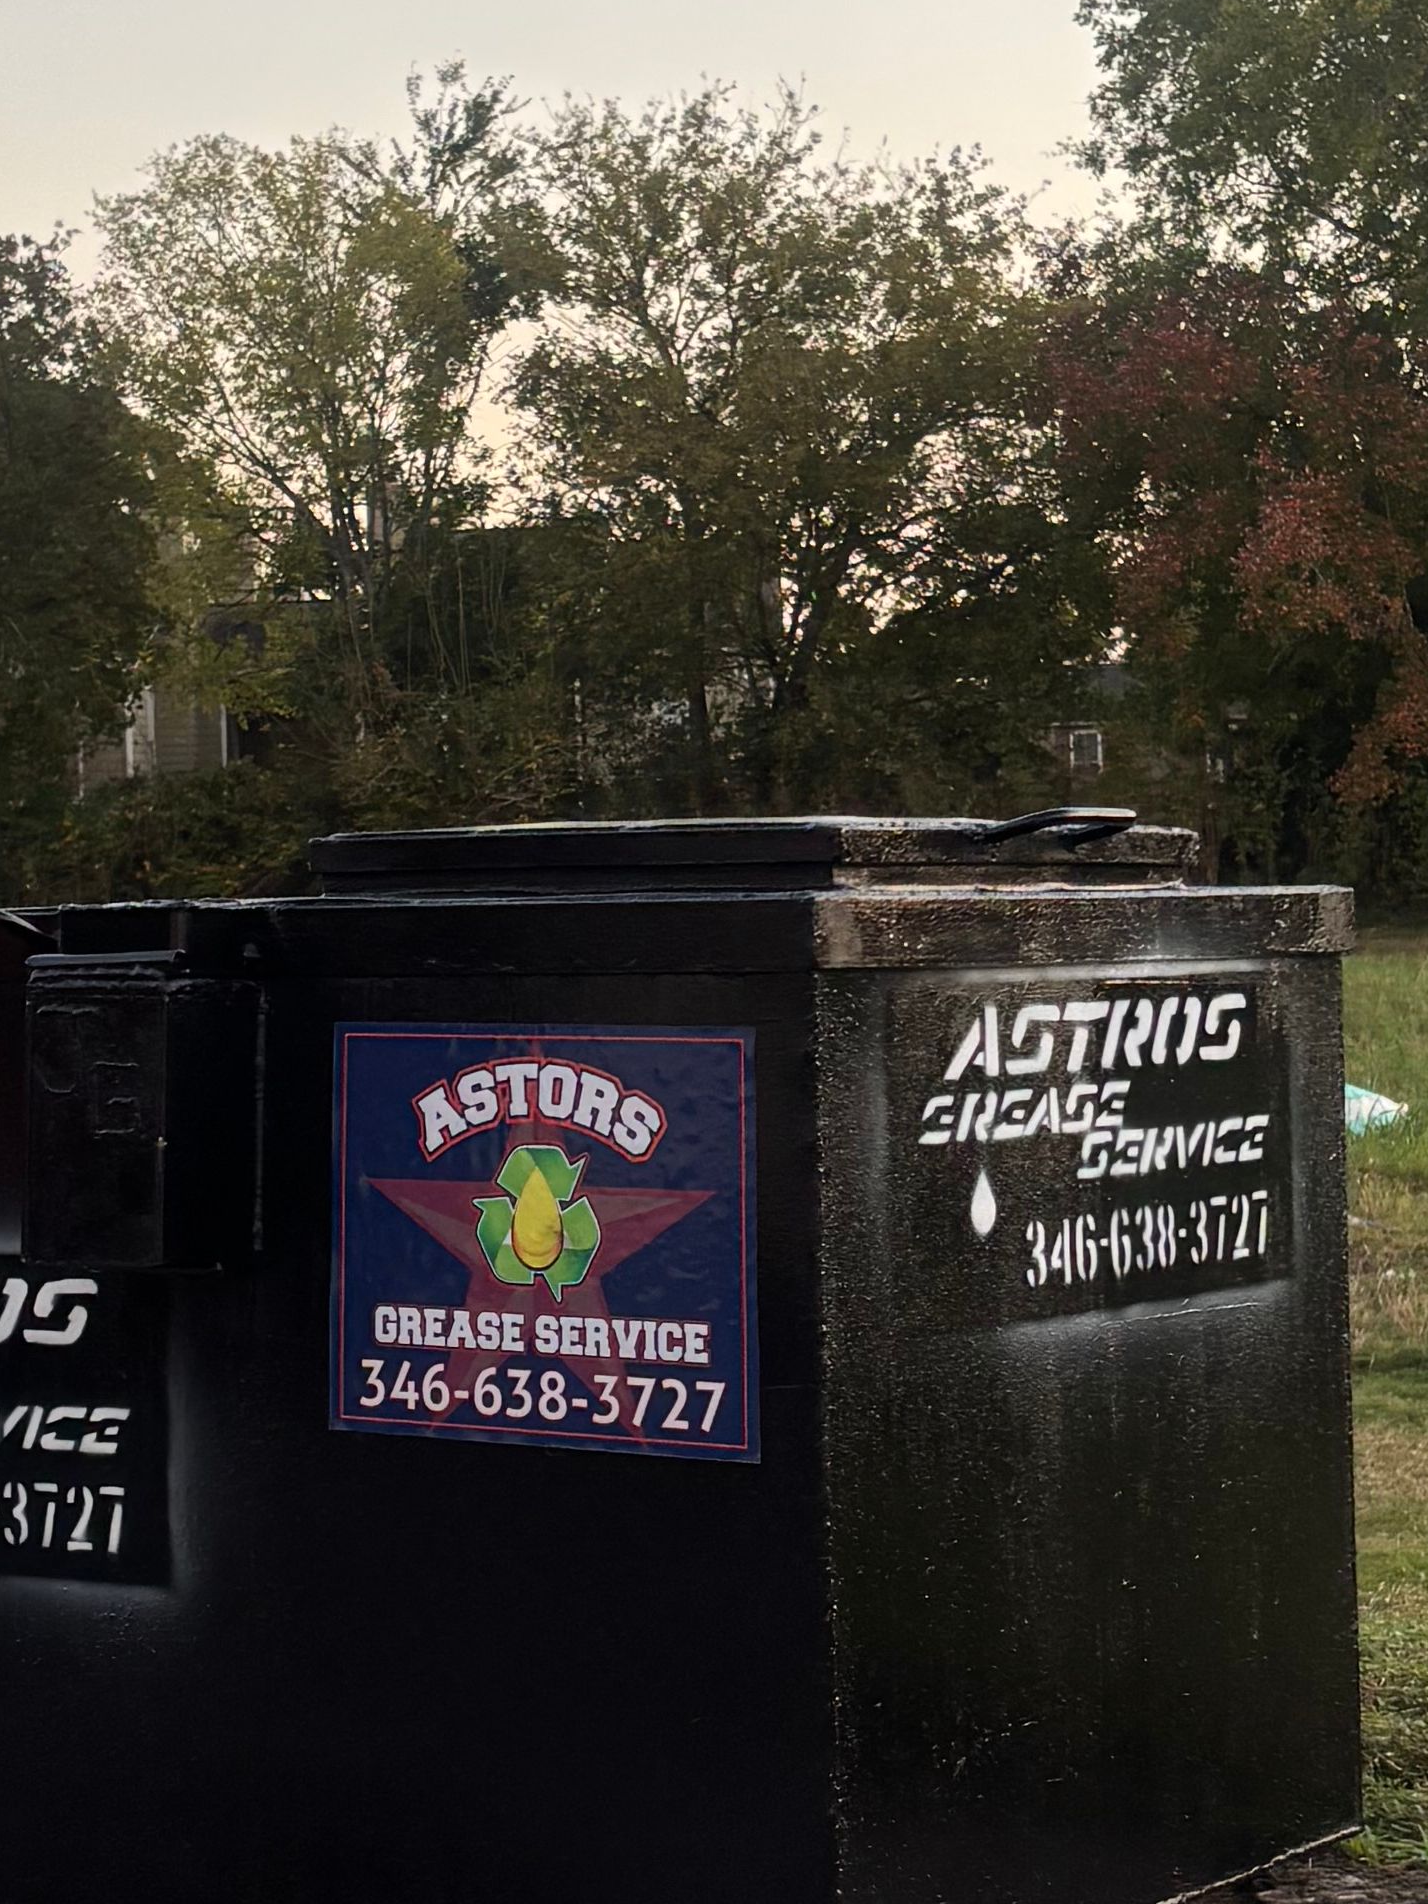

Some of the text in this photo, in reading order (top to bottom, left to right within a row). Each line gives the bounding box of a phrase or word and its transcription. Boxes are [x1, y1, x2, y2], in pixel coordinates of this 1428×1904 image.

[944, 993, 1246, 1080] ASTROS
[418, 1063, 661, 1156] ASTORS
[918, 1080, 1131, 1144] GREASE
[1077, 1114, 1270, 1179] SERVICE
[1026, 1190, 1268, 1288] 346-638-3727
[374, 1305, 710, 1363] GREASE SERVICE
[359, 1359, 726, 1432] 346-638-3727
